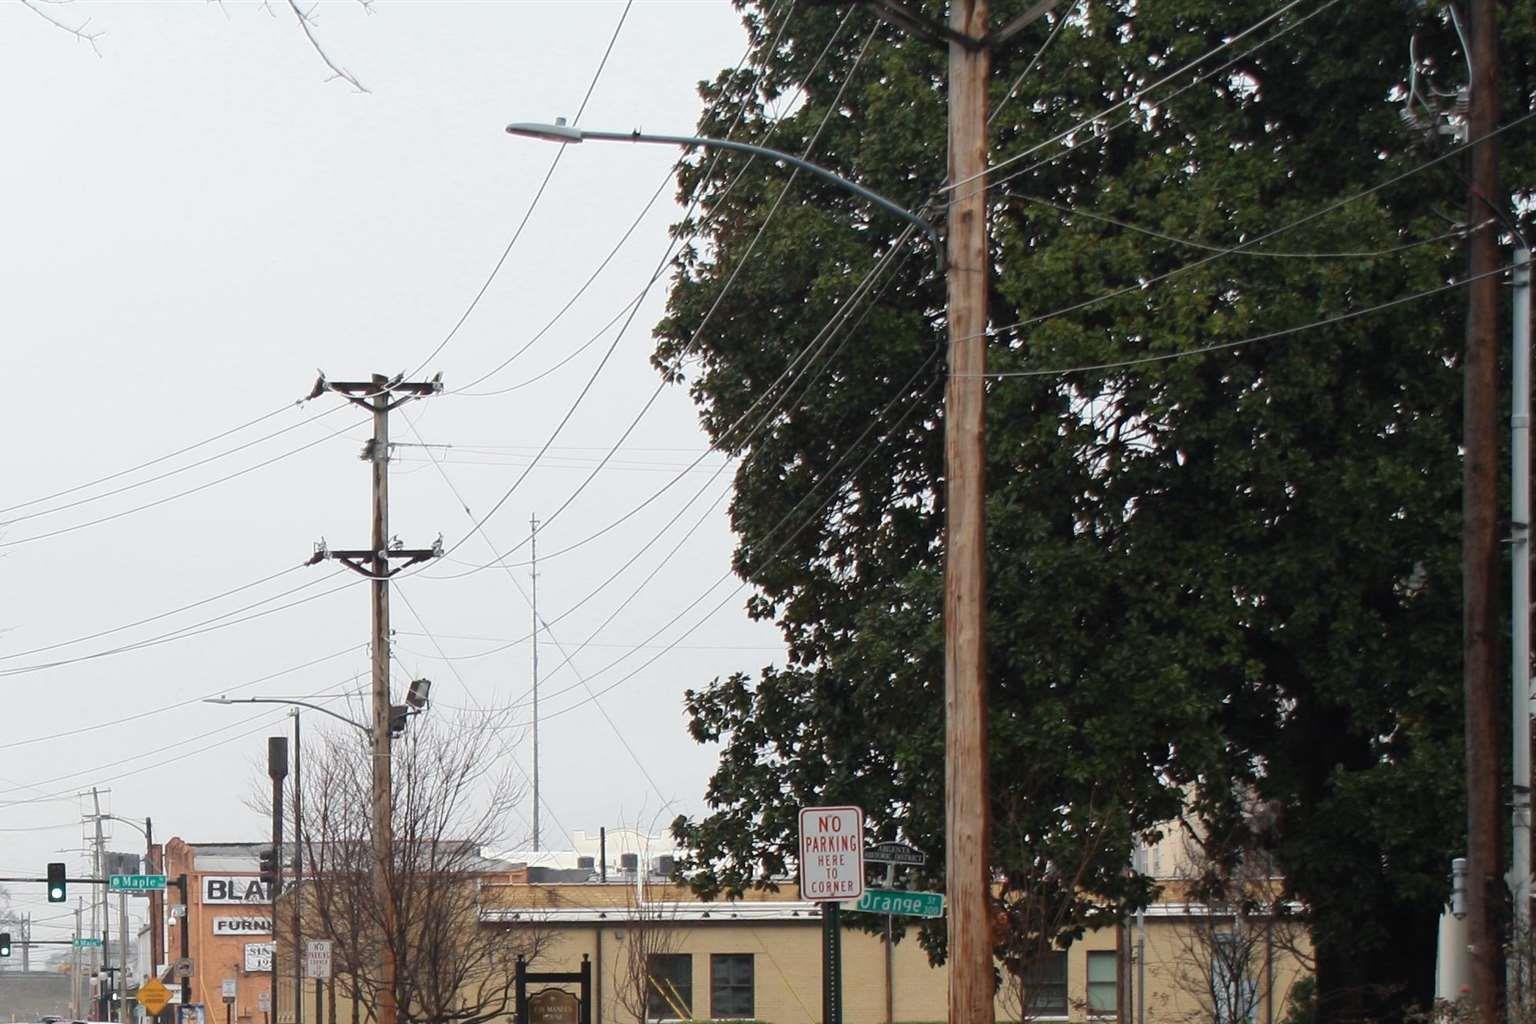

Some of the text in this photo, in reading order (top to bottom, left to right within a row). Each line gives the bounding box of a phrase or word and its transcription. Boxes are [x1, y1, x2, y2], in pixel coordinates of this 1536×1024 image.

[819, 816, 841, 832] NO
[805, 835, 857, 853] PARKING
[817, 854, 845, 867] HERE
[826, 867, 838, 880] TO
[123, 876, 156, 888] Maple
[811, 880, 854, 893] CORNER
[860, 892, 923, 913] Orange
